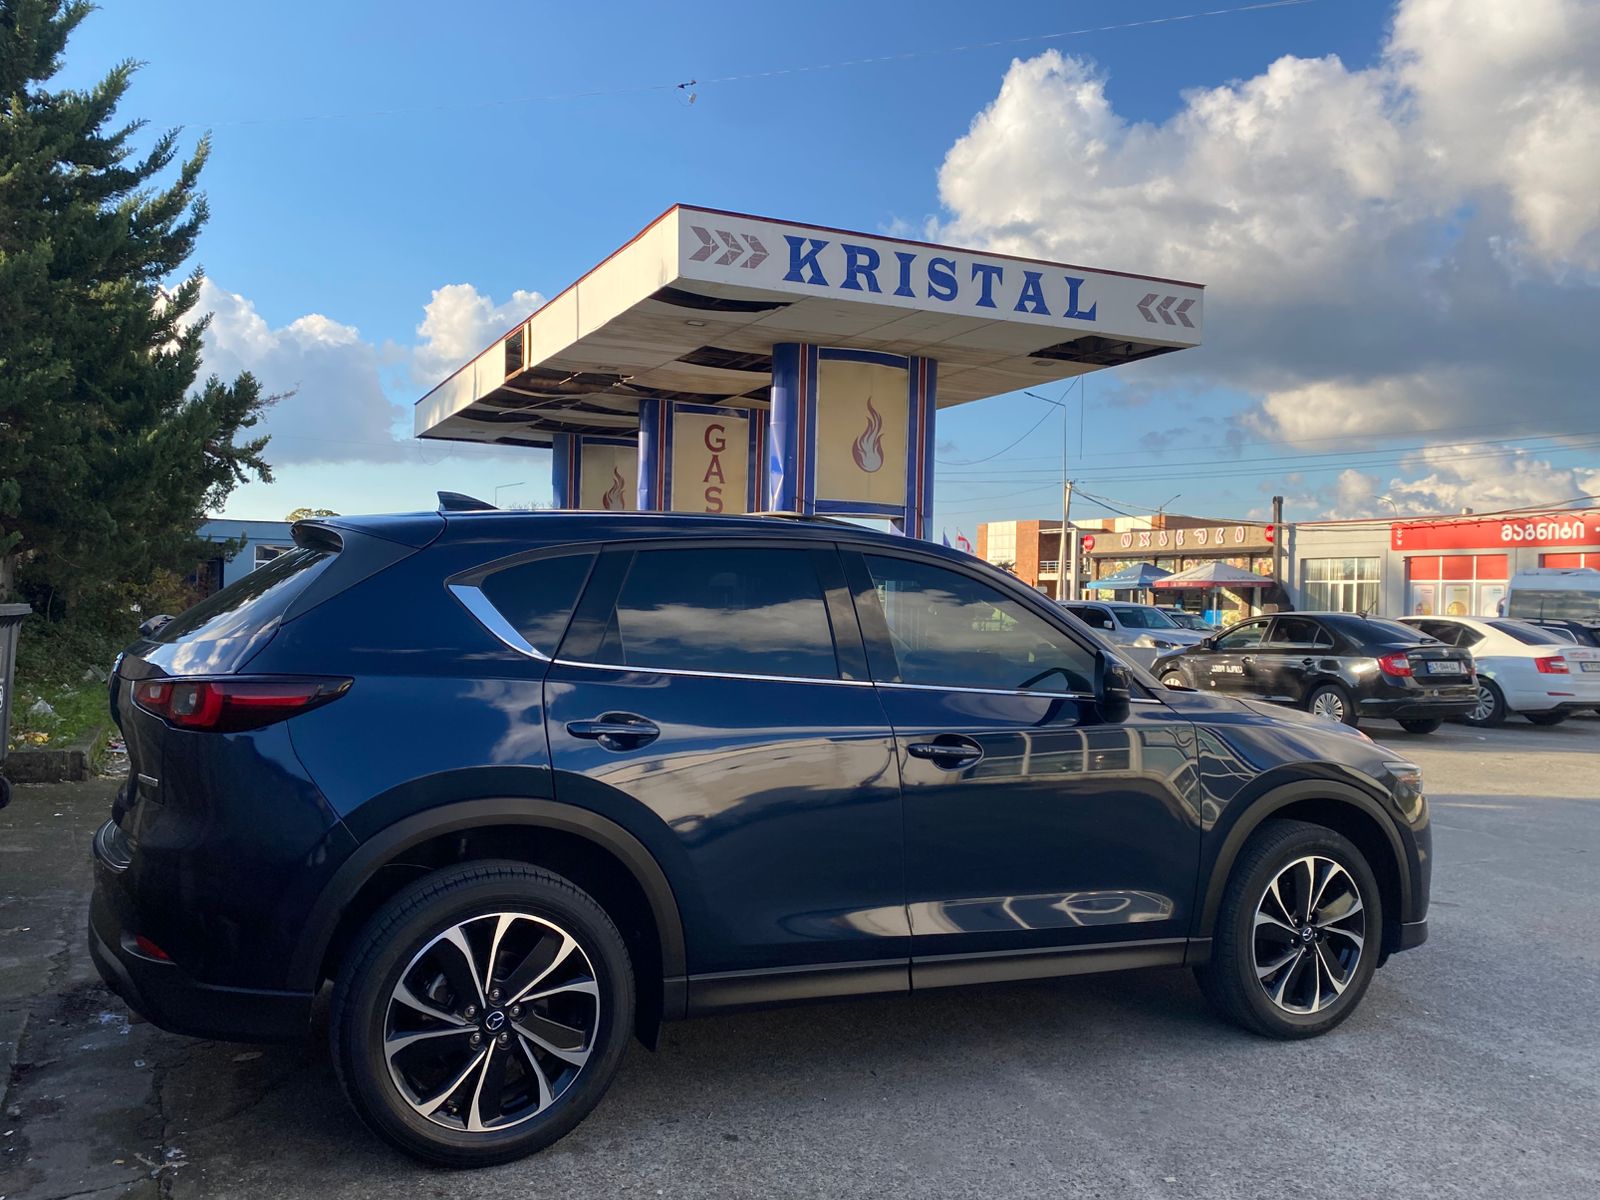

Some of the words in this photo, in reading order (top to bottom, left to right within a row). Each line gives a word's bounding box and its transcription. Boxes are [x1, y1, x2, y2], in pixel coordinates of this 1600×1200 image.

[783, 235, 1098, 322] KRISTAL
[704, 424, 726, 513] GAS
[1501, 522, 1584, 541] მაგნიტი
